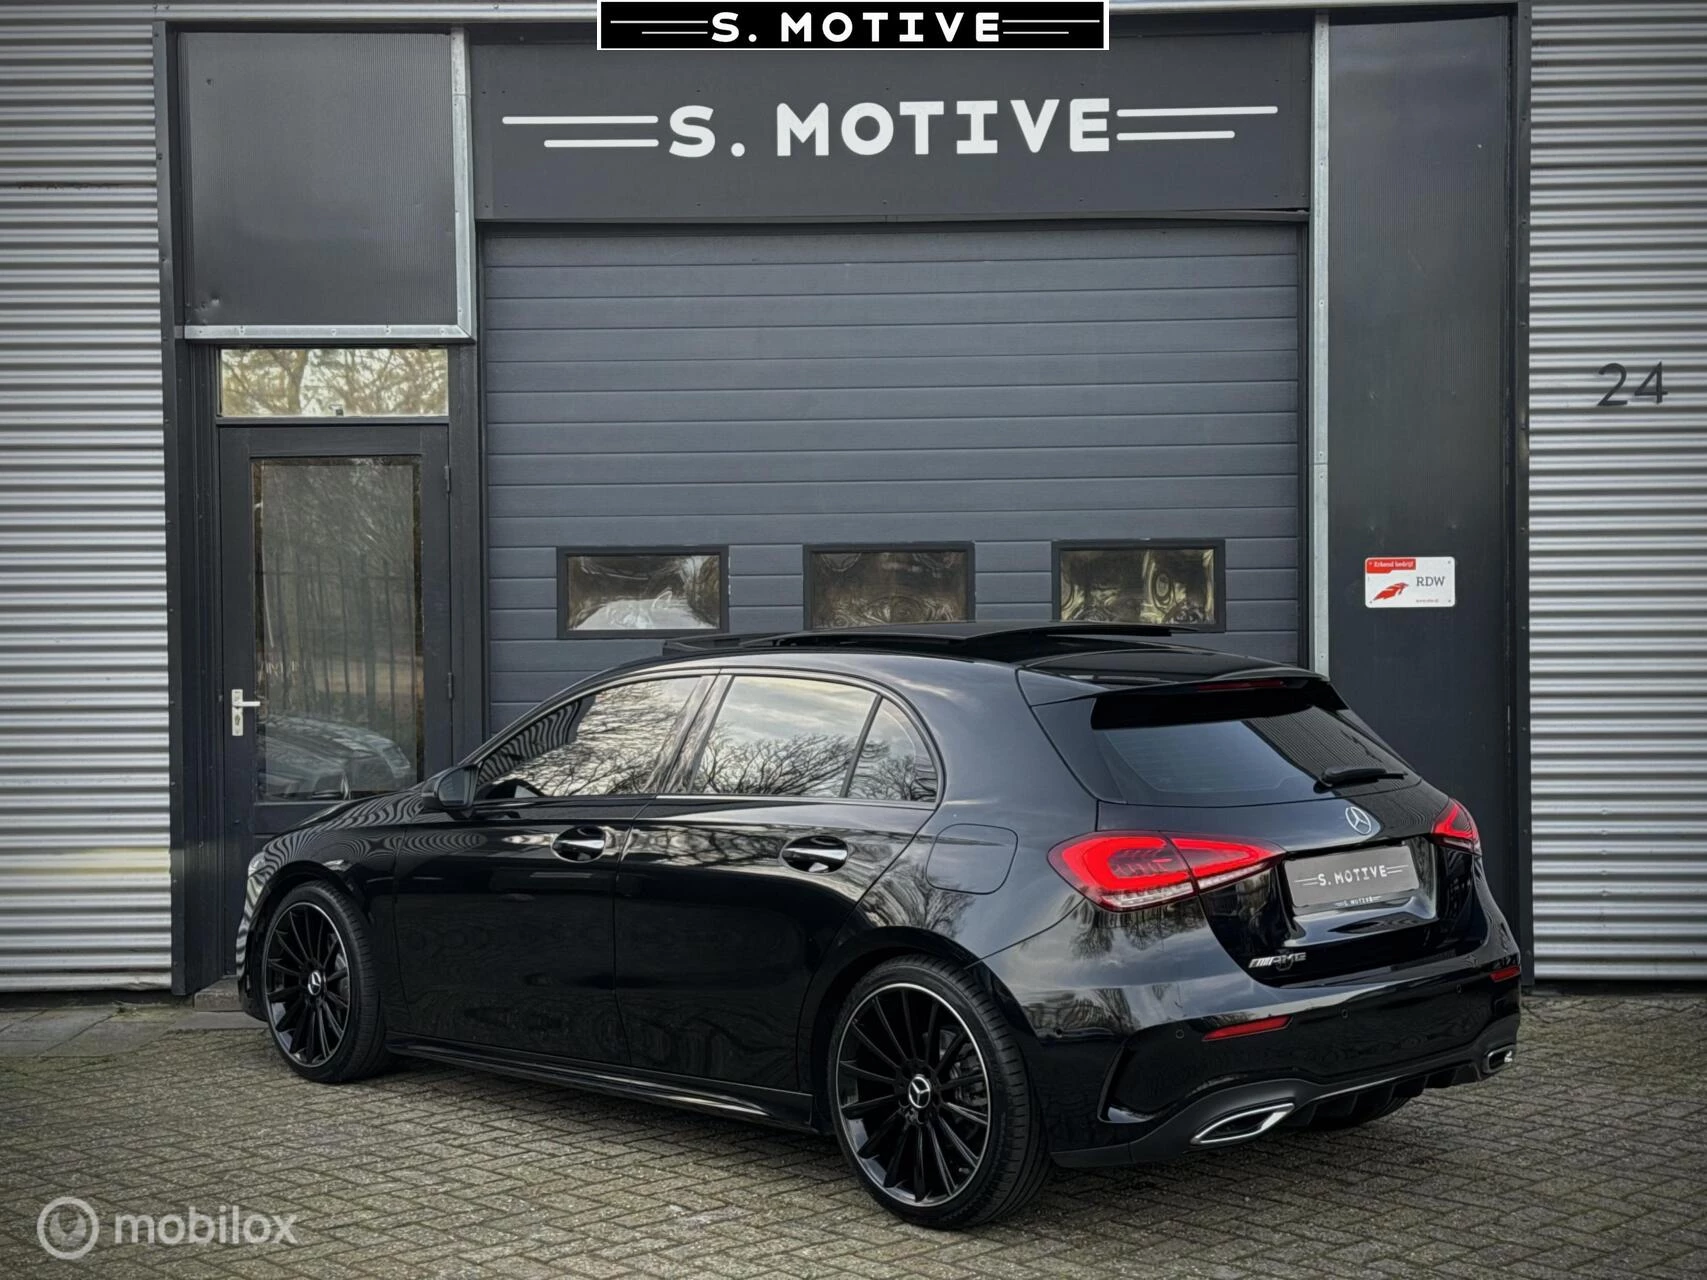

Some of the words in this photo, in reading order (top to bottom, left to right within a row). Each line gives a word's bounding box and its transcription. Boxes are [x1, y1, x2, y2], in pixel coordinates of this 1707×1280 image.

[668, 104, 746, 158] S.
[776, 97, 1110, 157] MOTIVE
[1597, 361, 1668, 406] 24
[1416, 576, 1445, 587] RDW
[1318, 873, 1332, 886] S.
[1334, 865, 1388, 885] MOTIVE
